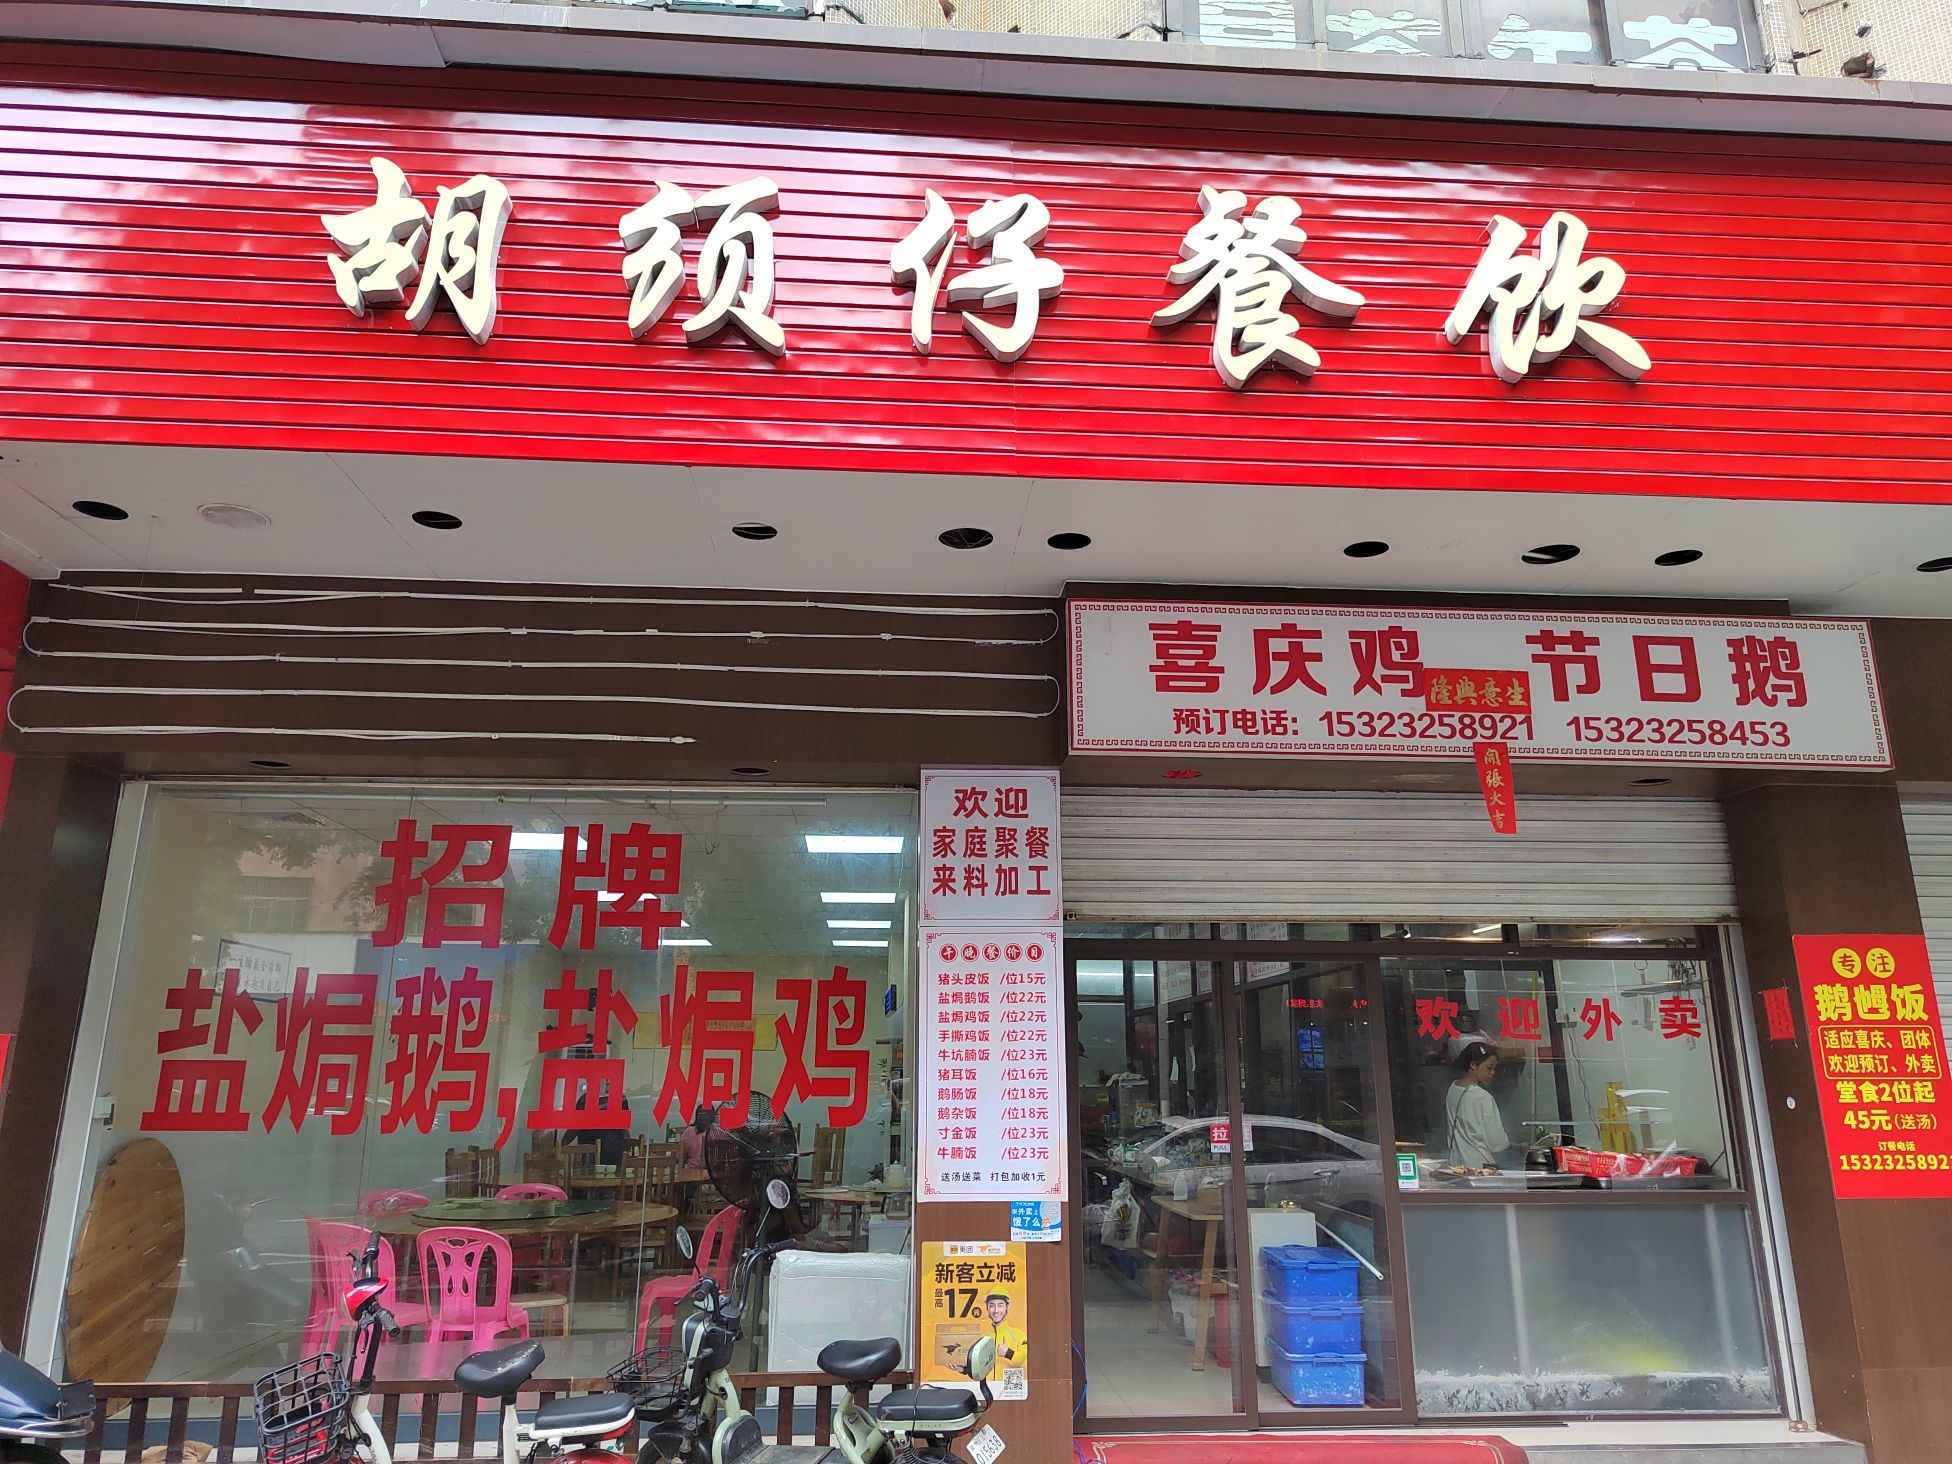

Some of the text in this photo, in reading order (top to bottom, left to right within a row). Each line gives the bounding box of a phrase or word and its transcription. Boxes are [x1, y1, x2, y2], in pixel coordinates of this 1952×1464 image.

[1149, 620, 1808, 708] 喜庆鸡 节日鹅
[1319, 710, 1534, 741] 15323258921
[1567, 715, 1791, 748] 15323258453
[952, 786, 1029, 819] 欢迎
[932, 826, 1050, 859] 家庭聚餐
[373, 820, 683, 950] 招牌
[932, 863, 1051, 897] 来料加工
[1835, 950, 1894, 977] 专注
[938, 972, 1046, 986] 猪头皮饭 /位15元
[938, 991, 1046, 1005] 盐焗鹅饭 /位22元
[938, 1010, 1046, 1024] 盐焗鸡饭 /位22元
[1415, 996, 1702, 1042] 欢迎外卖
[938, 1029, 1047, 1043] 手撕鸡饭 /位22元
[1823, 1030, 1932, 1050] 适应喜庆、团体
[938, 1048, 1047, 1062] 牛坑腩饭 /位23元
[1828, 1054, 1938, 1075] 欢迎预订、外卖
[938, 1067, 1047, 1081] 猪耳饭 /位16元
[937, 1087, 1048, 1101] 鹅肠饭 /位18元
[1835, 1080, 1937, 1104] 堂食2位起
[937, 1106, 1048, 1120] 鹅杂饭 /位18元
[938, 1126, 1048, 1140] 寸金饭 /位23元
[1212, 1127, 1229, 1142] 拉
[937, 1146, 1049, 1160] 牛腩饭 /位23元
[1877, 1141, 1916, 1152] 订餐电话
[941, 1171, 1046, 1182] 送汤送菜 打包加收1元
[1013, 1216, 1041, 1228] 饿了么
[935, 1261, 1017, 1284] 新客立减
[934, 1288, 944, 1309] 最高
